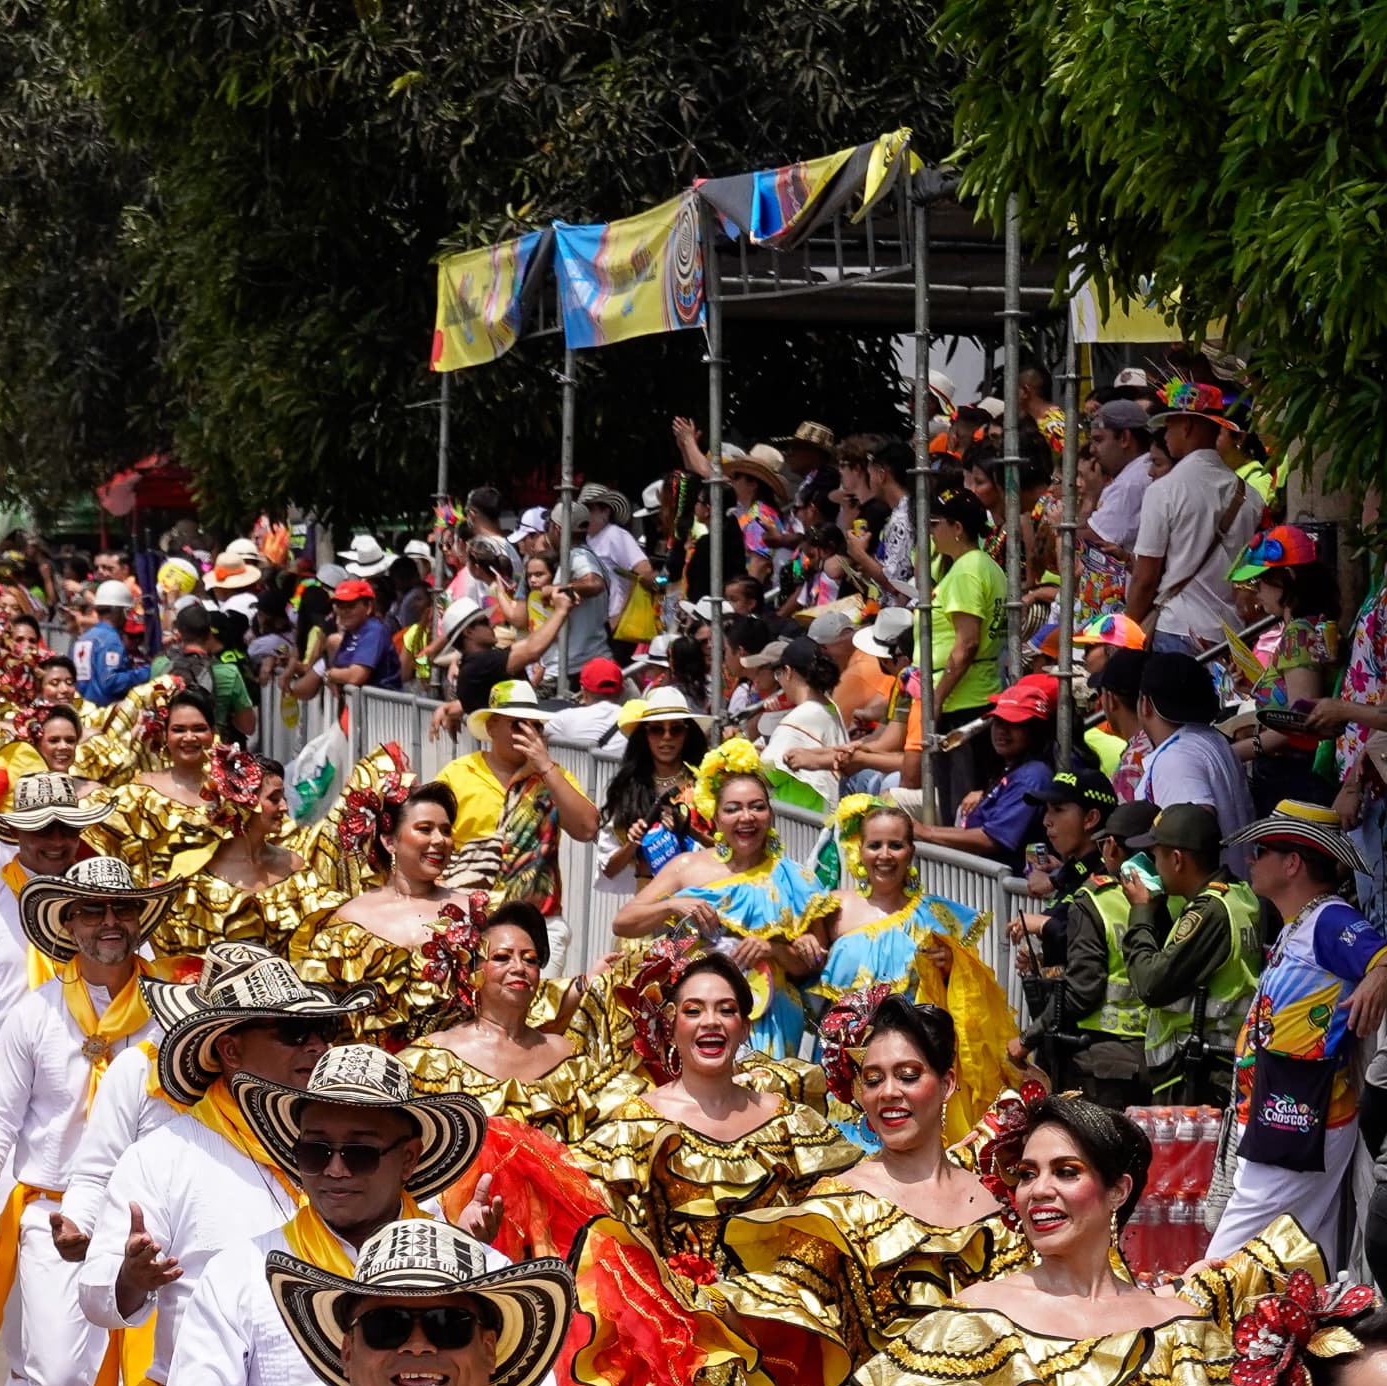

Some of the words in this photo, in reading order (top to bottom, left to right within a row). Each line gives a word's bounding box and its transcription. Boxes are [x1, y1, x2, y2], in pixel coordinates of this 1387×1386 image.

[1275, 1100, 1298, 1114] CASA
[354, 1258, 406, 1282] UMBION
[414, 1257, 438, 1268] DE
[439, 1261, 468, 1281] ORO
